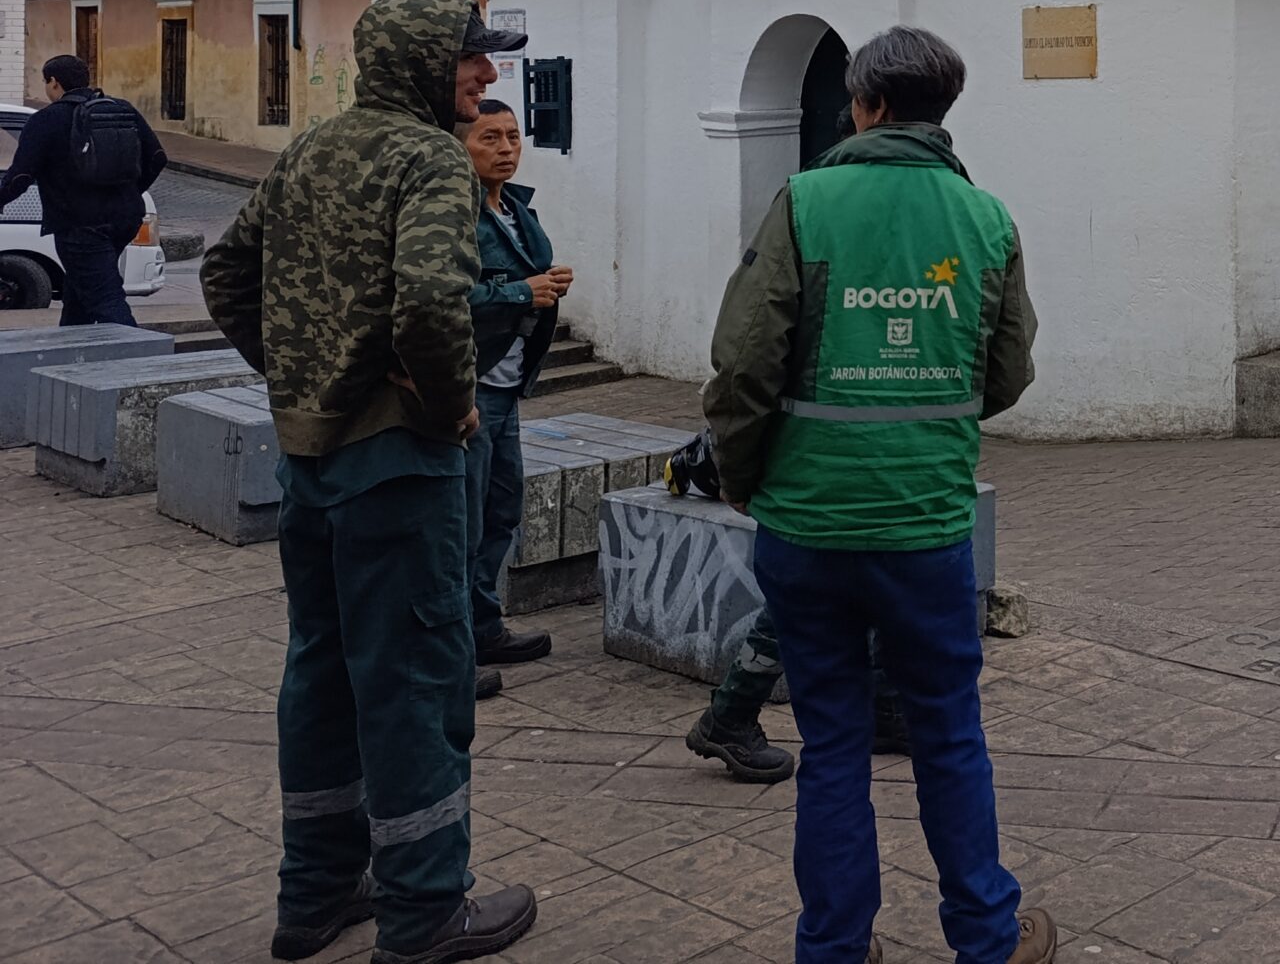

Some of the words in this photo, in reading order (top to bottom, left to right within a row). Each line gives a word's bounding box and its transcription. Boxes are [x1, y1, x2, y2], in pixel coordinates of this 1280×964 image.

[830, 364, 866, 380] JARDÍN
[868, 364, 917, 380] BOTÁNICO
[919, 365, 962, 380] BOGOTÁ
